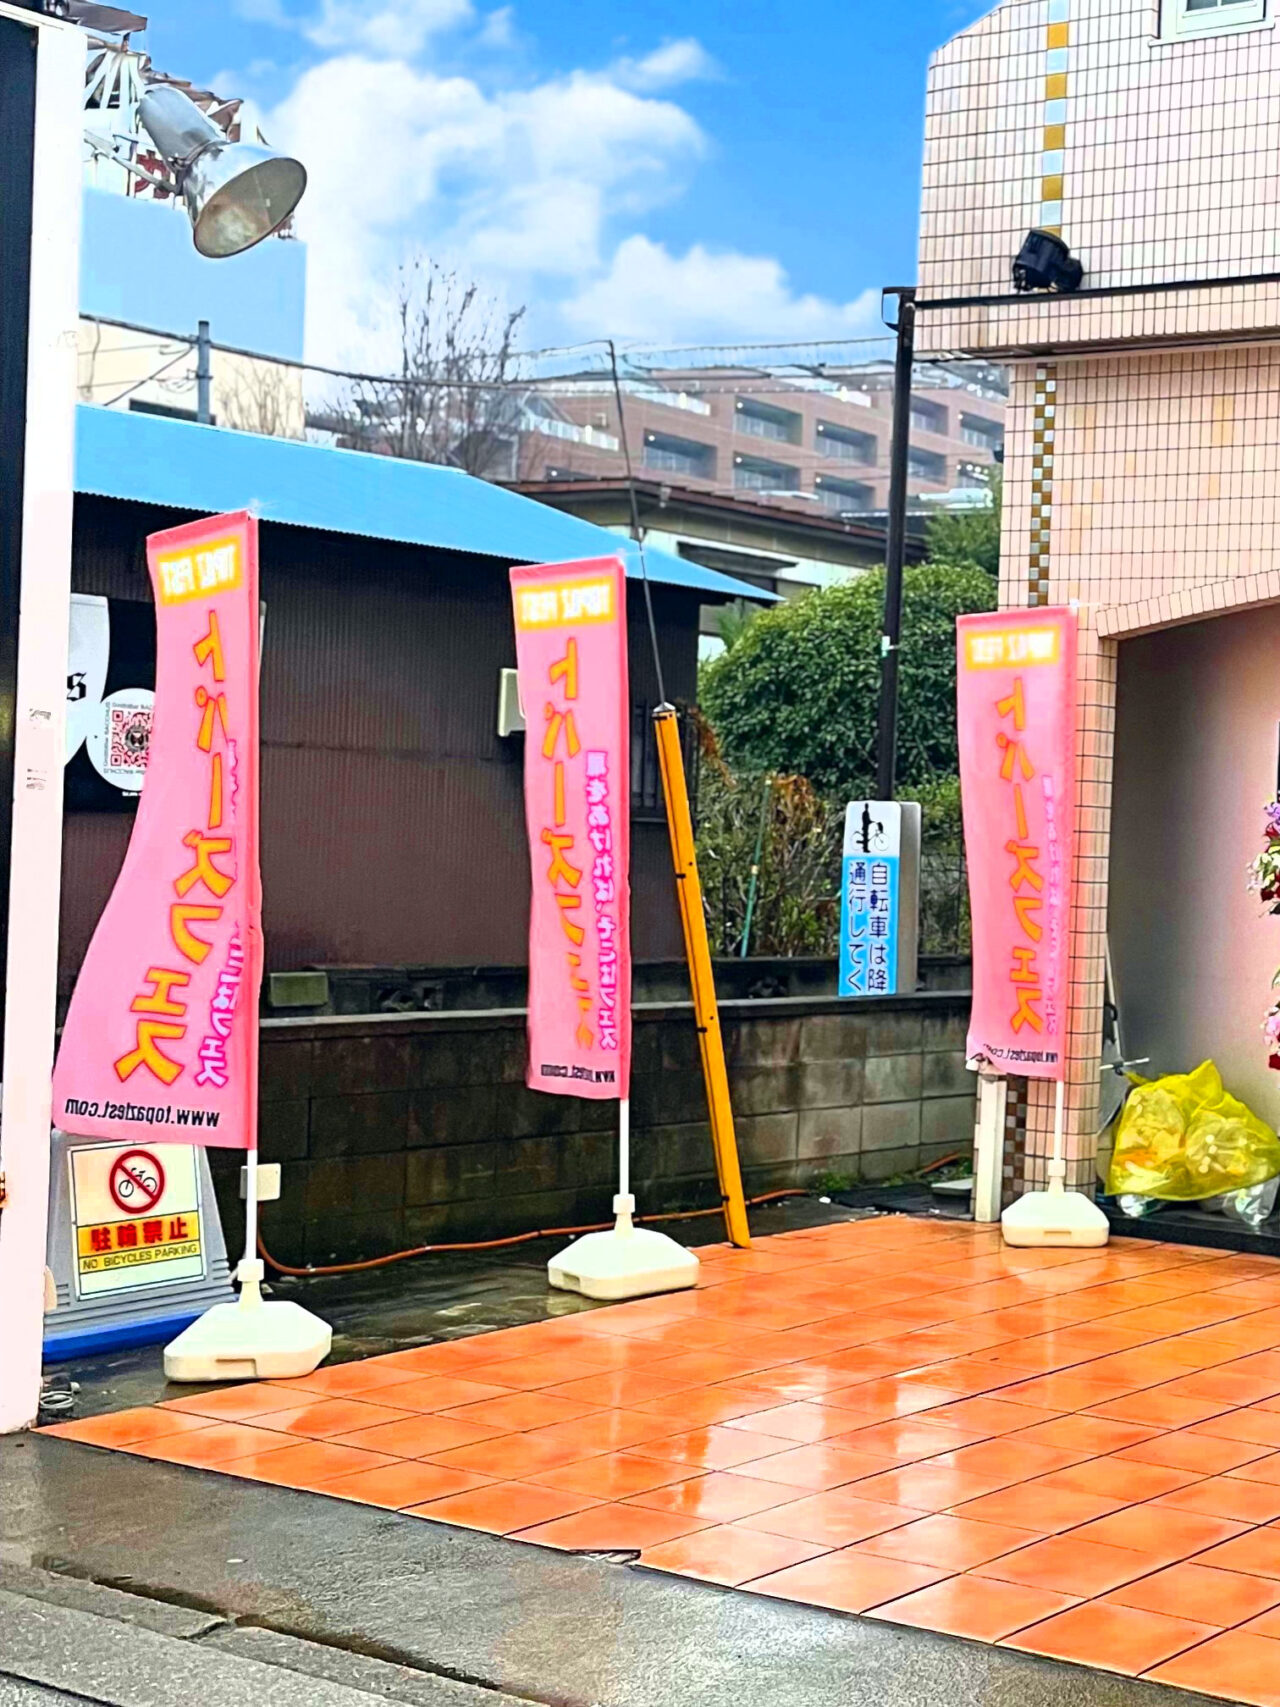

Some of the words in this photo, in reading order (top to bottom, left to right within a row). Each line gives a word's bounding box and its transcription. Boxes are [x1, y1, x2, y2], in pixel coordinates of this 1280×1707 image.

[848, 861, 867, 992] 通行してく
[867, 863, 889, 992] 自転車は降
[82, 1258, 98, 1271] NO
[103, 1250, 153, 1267] BICYCLES
[154, 1243, 198, 1260] PARKING
[90, 1216, 189, 1252] 駐輪禁止
